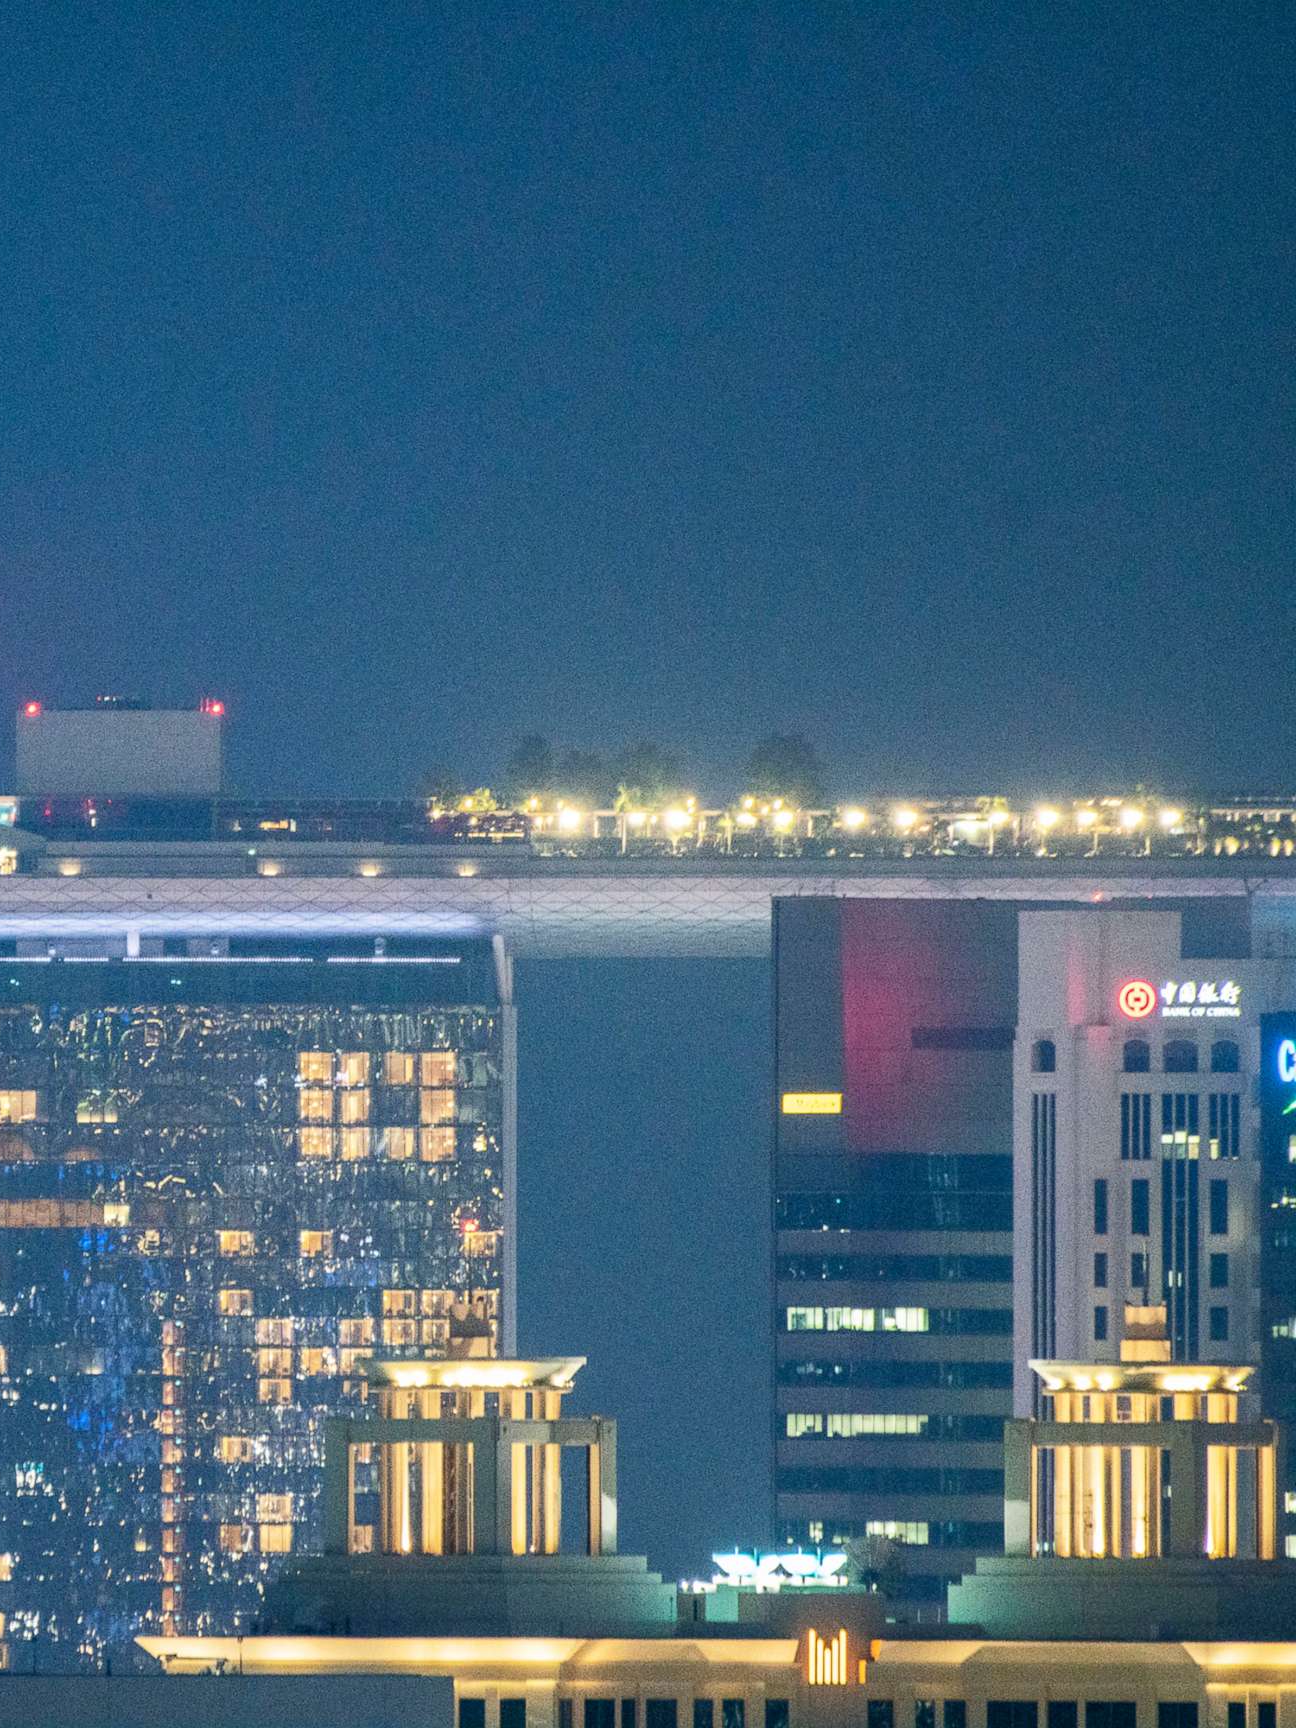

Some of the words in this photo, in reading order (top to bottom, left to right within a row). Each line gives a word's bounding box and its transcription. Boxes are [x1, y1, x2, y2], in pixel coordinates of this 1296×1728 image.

[1162, 1007, 1191, 1017] BANK
[1191, 1007, 1206, 1017] OF
[1206, 1007, 1241, 1017] CHINA
[1279, 1039, 1296, 1082] C
